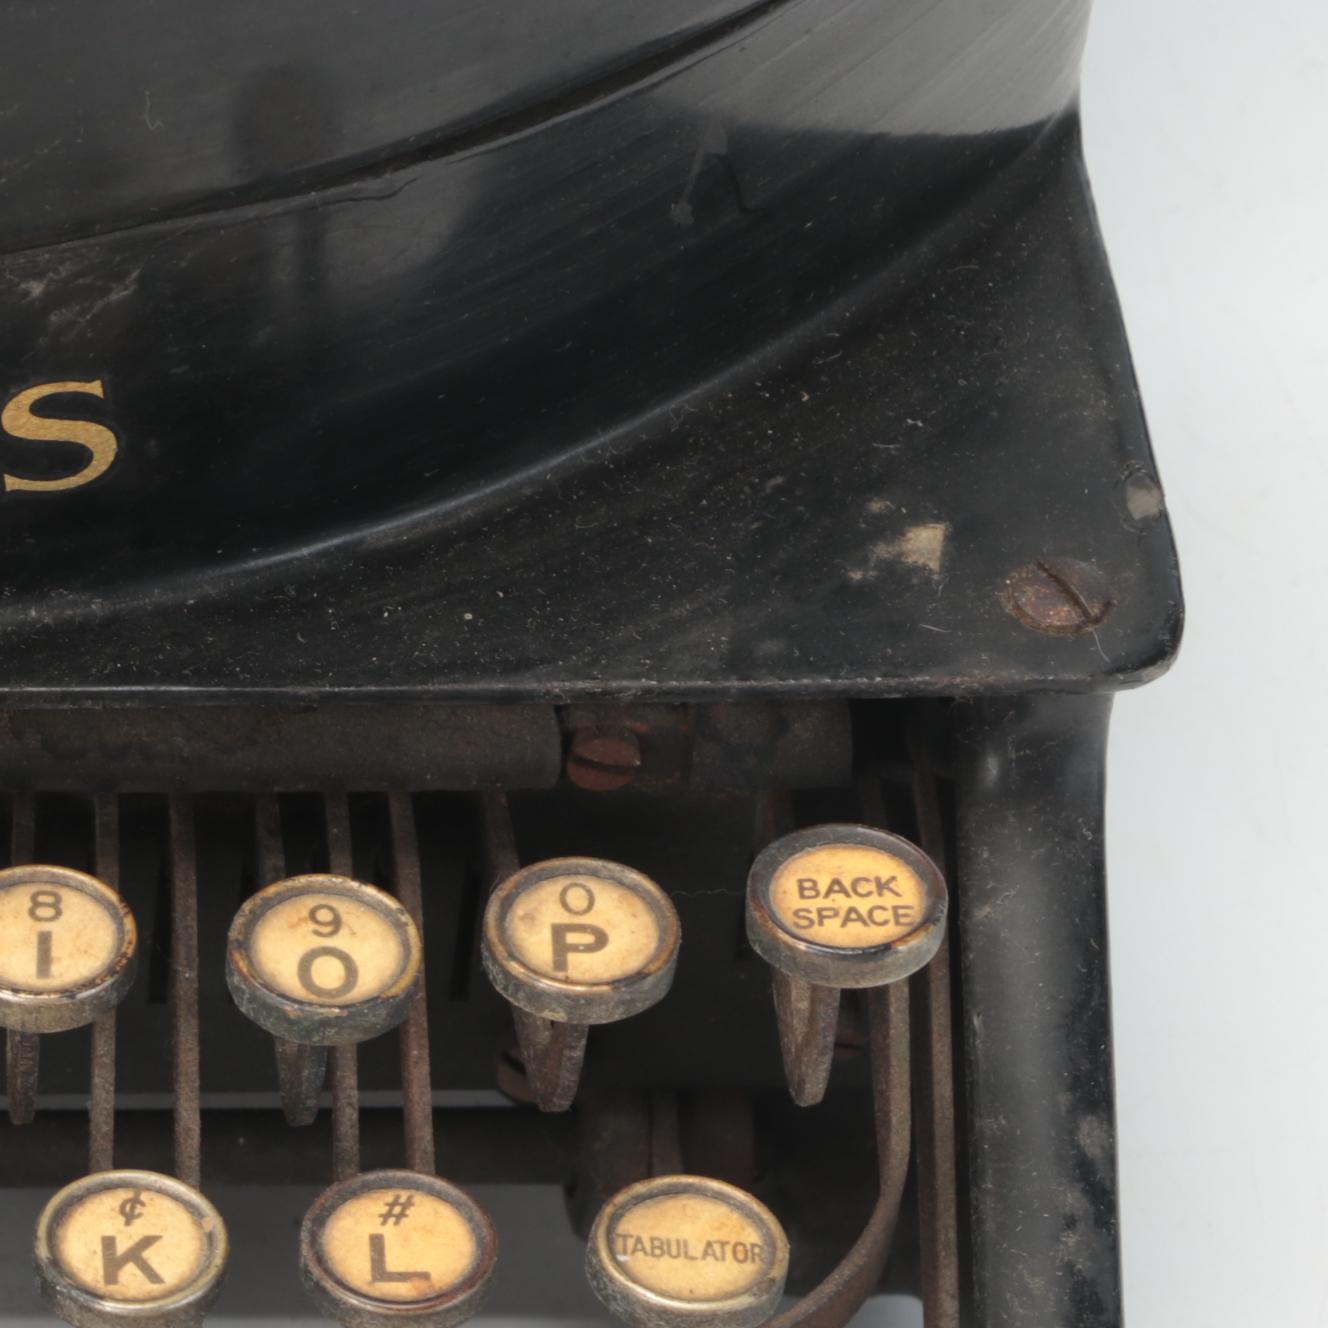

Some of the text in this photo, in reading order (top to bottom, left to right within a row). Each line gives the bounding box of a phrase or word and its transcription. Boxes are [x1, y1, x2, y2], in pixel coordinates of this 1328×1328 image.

[796, 875, 902, 900] BACK
[27, 890, 63, 923] 8
[307, 904, 341, 938] 9
[792, 904, 915, 931] SPACE
[35, 931, 53, 979] I
[550, 923, 610, 973] P
[296, 946, 359, 1000] O
[378, 1194, 415, 1227] #
[100, 1234, 166, 1286] K
[368, 1233, 432, 1283] L
[616, 1233, 765, 1266] TABULATOR
